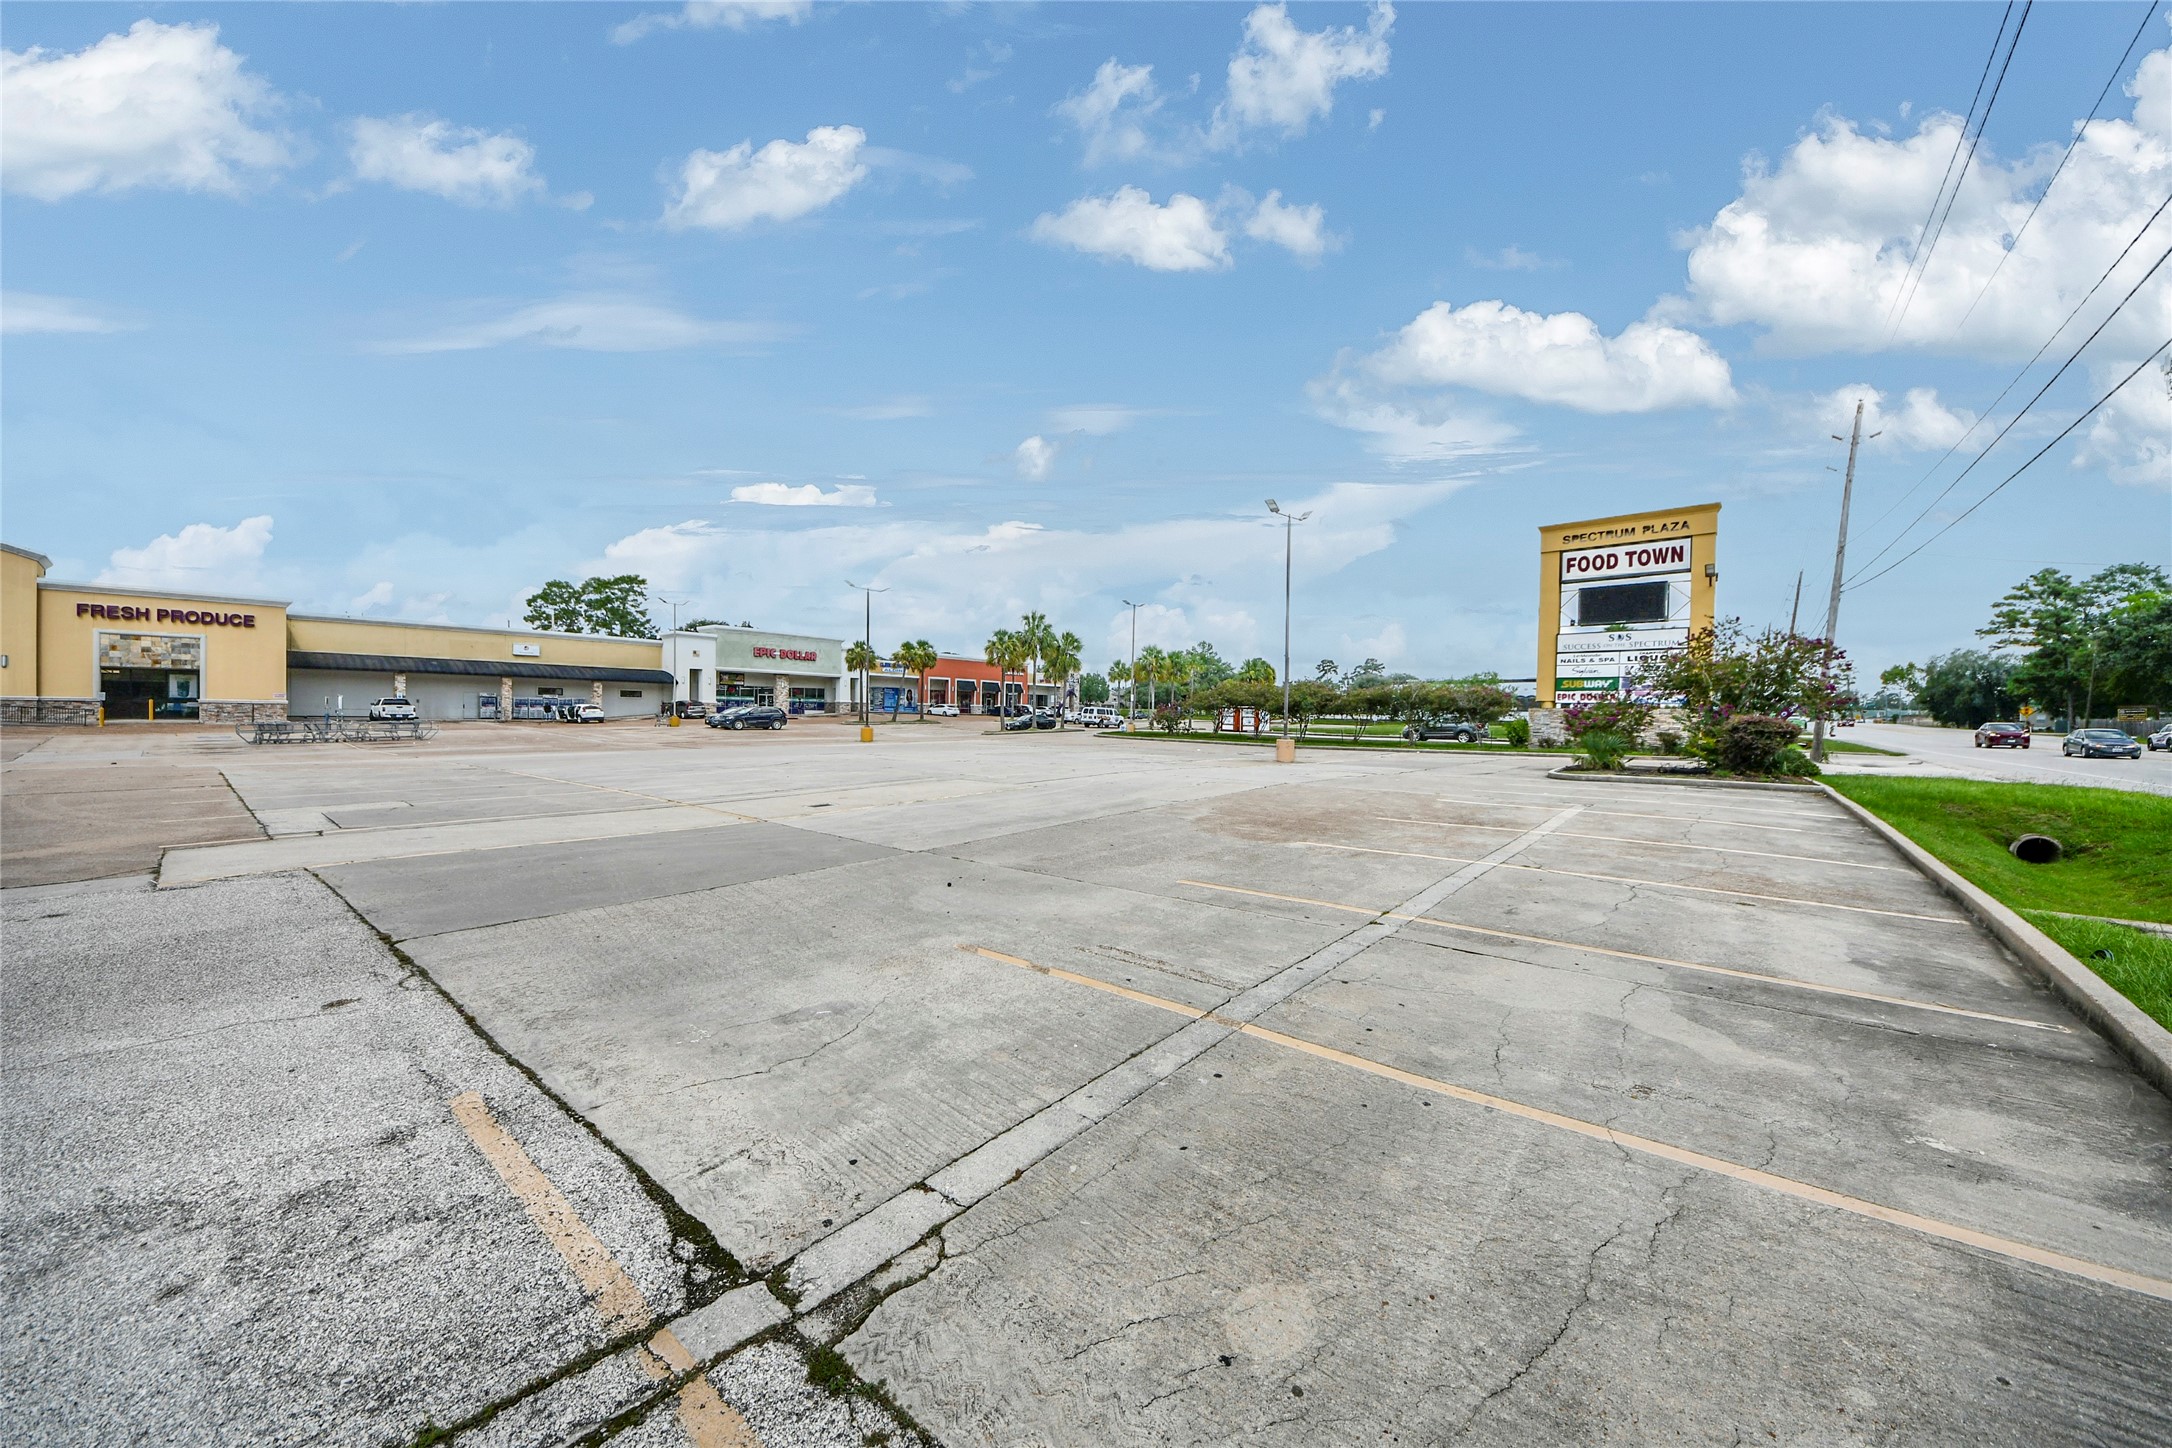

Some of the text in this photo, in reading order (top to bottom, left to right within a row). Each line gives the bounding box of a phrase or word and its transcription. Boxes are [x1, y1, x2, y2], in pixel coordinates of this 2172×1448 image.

[1562, 520, 1690, 545] SPECTRUM PLAZA
[1566, 545, 1684, 574] FOOD TOWN
[76, 602, 256, 628] FRESH PRODUCE
[1562, 642, 1601, 651] SUCCESS
[1629, 639, 1680, 648] SPECTRUM
[753, 646, 817, 662] EPIC DOLLAR
[1560, 679, 1614, 689] SUBWAY
[1557, 693, 1577, 701] EPIC
